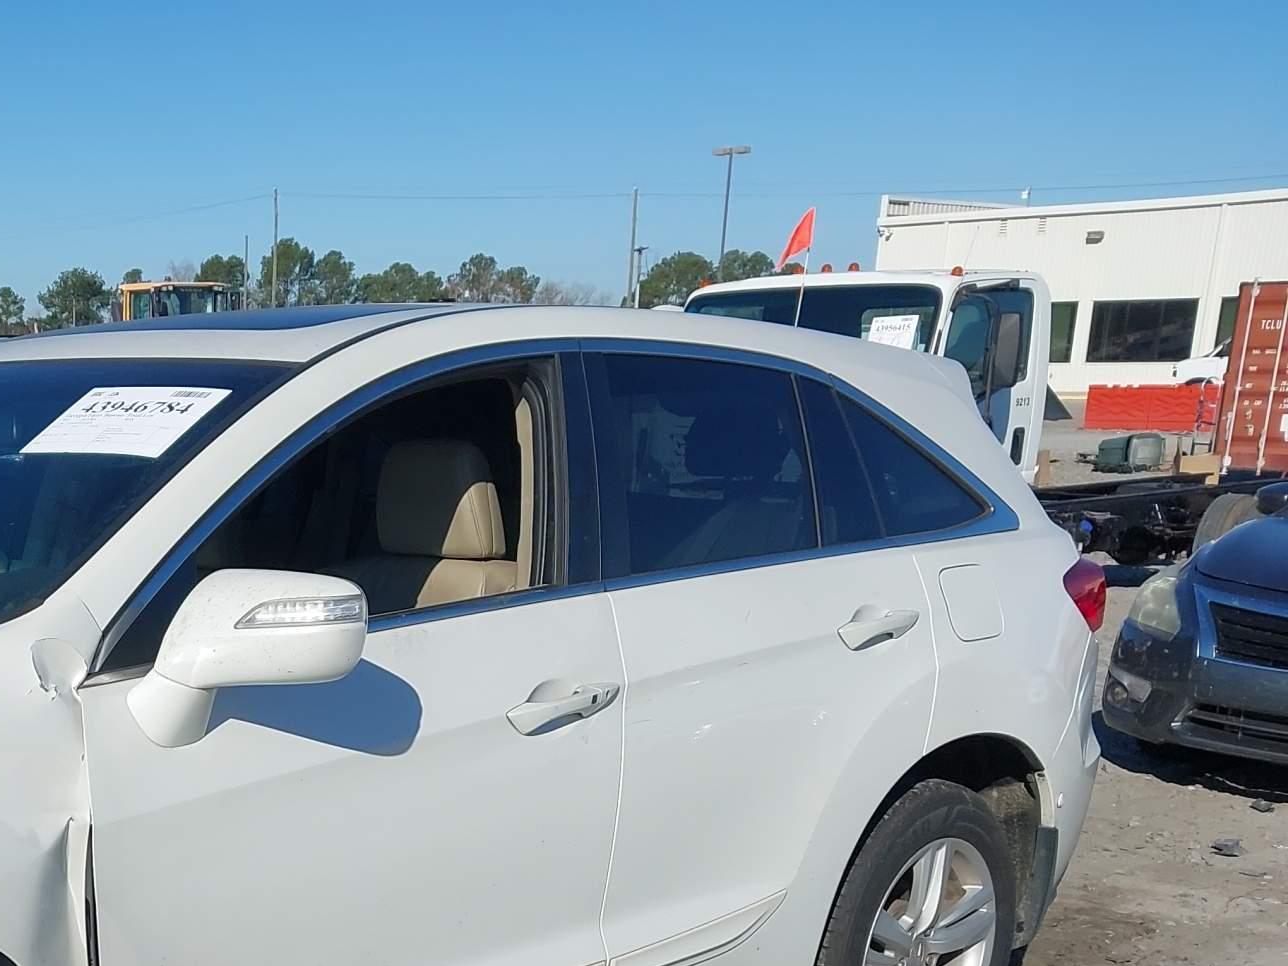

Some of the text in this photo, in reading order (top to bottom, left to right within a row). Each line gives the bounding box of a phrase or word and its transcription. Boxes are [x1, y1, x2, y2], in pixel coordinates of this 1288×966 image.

[1261, 319, 1282, 330] TCLU
[1015, 396, 1031, 407] 9213
[81, 400, 195, 415] 43946784
